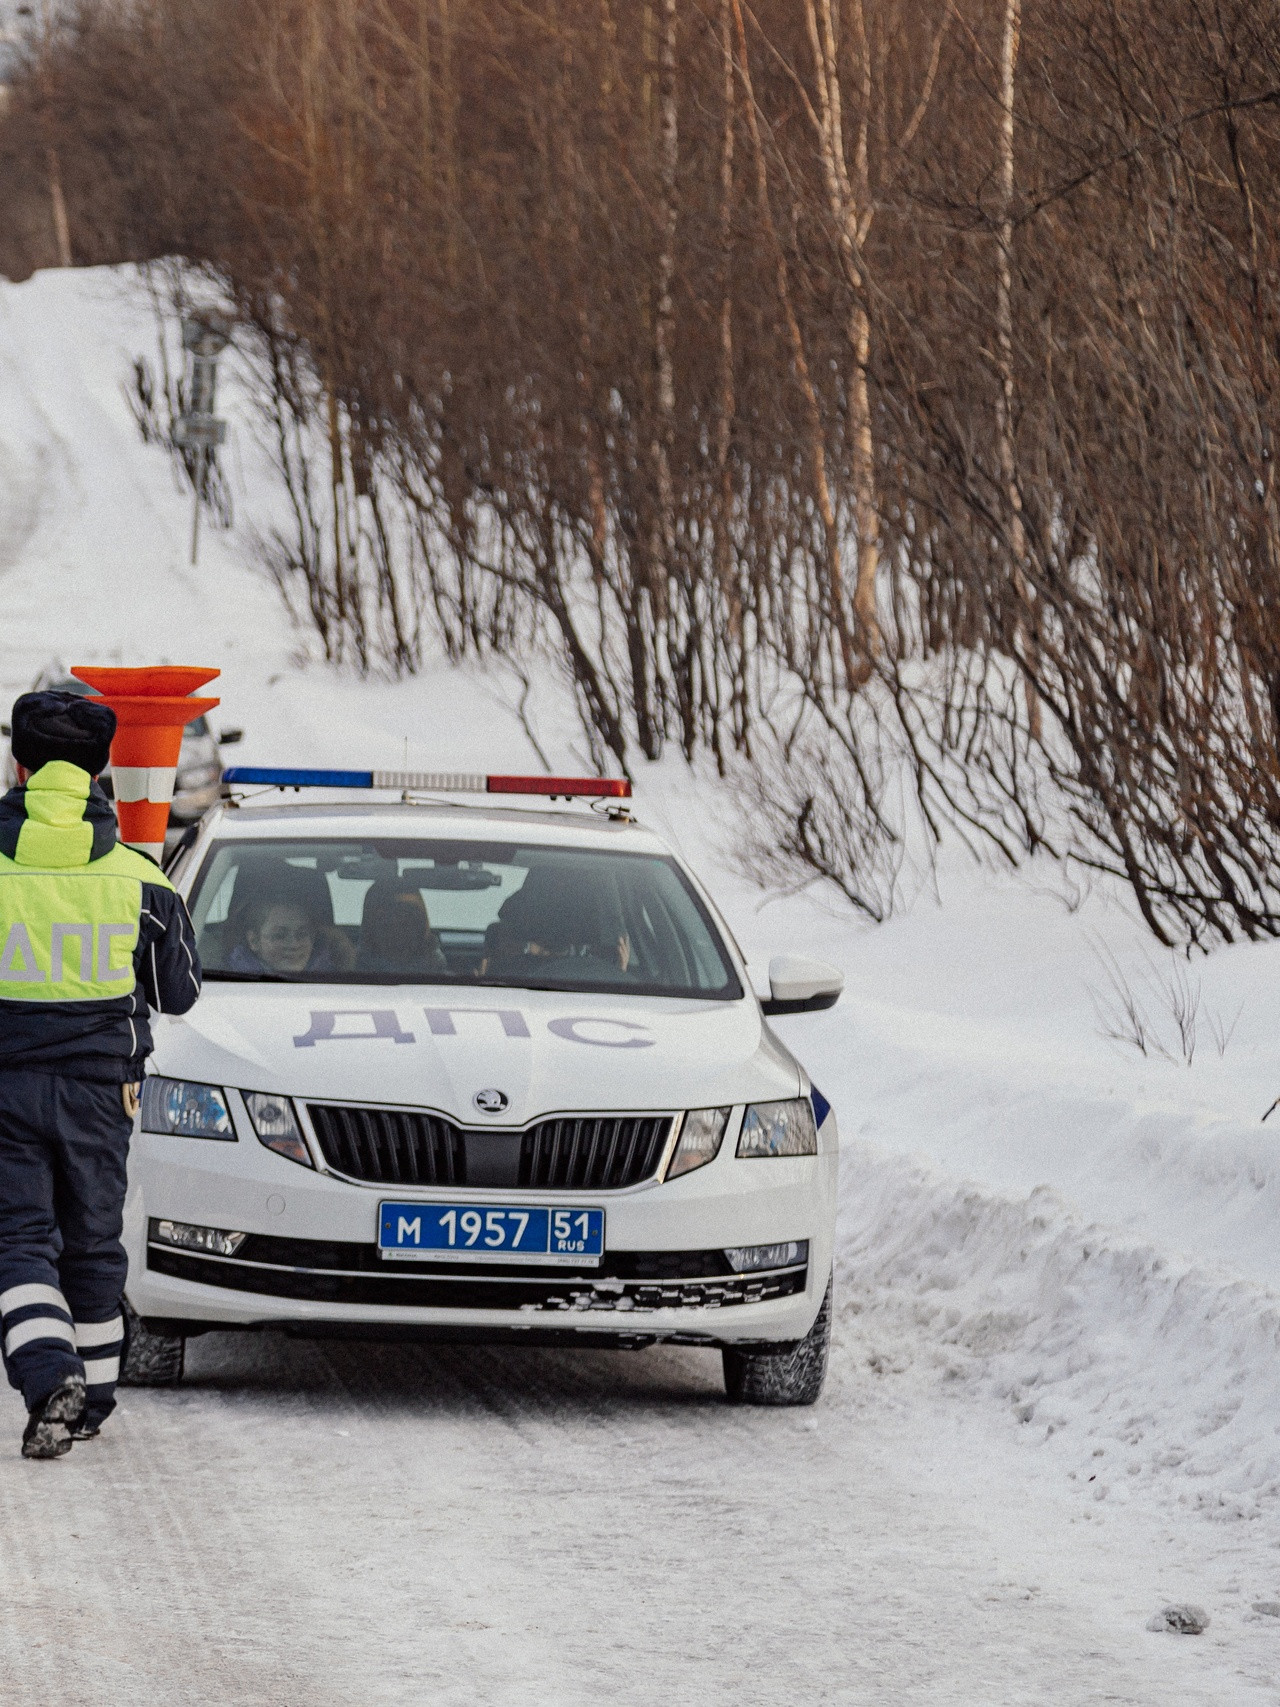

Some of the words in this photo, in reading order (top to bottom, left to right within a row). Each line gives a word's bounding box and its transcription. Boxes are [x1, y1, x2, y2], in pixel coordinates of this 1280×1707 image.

[292, 1008, 657, 1049] ДПС
[438, 1209, 530, 1248] 1957
[554, 1211, 589, 1240] 51
[557, 1240, 585, 1252] RUS
